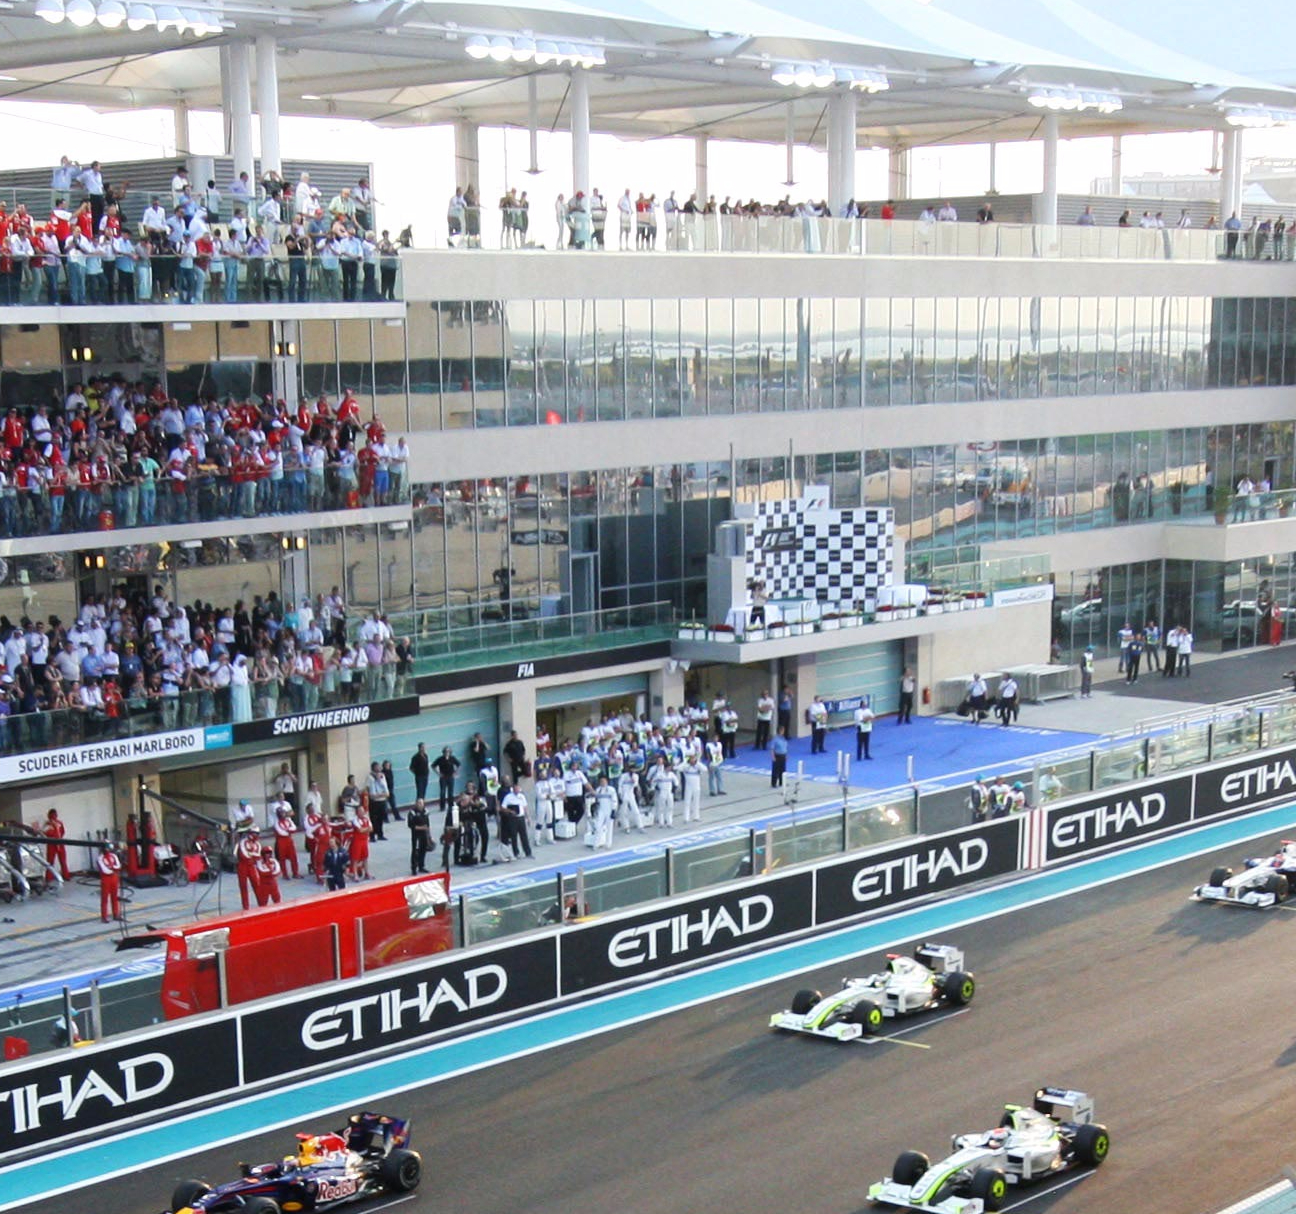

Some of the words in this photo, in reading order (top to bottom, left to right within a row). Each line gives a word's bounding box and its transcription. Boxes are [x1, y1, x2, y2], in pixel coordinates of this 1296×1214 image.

[517, 663, 534, 678] FIA
[273, 706, 369, 735] SCRUTINEERING
[19, 752, 77, 773] SCUDERIA
[80, 744, 131, 765] FERRARI
[133, 735, 195, 757] MARLBORO
[1052, 793, 1165, 847] ETIHAD
[852, 838, 988, 901] ETIHAD
[608, 895, 773, 967] ETIHAD
[302, 964, 507, 1050] ETIHAD
